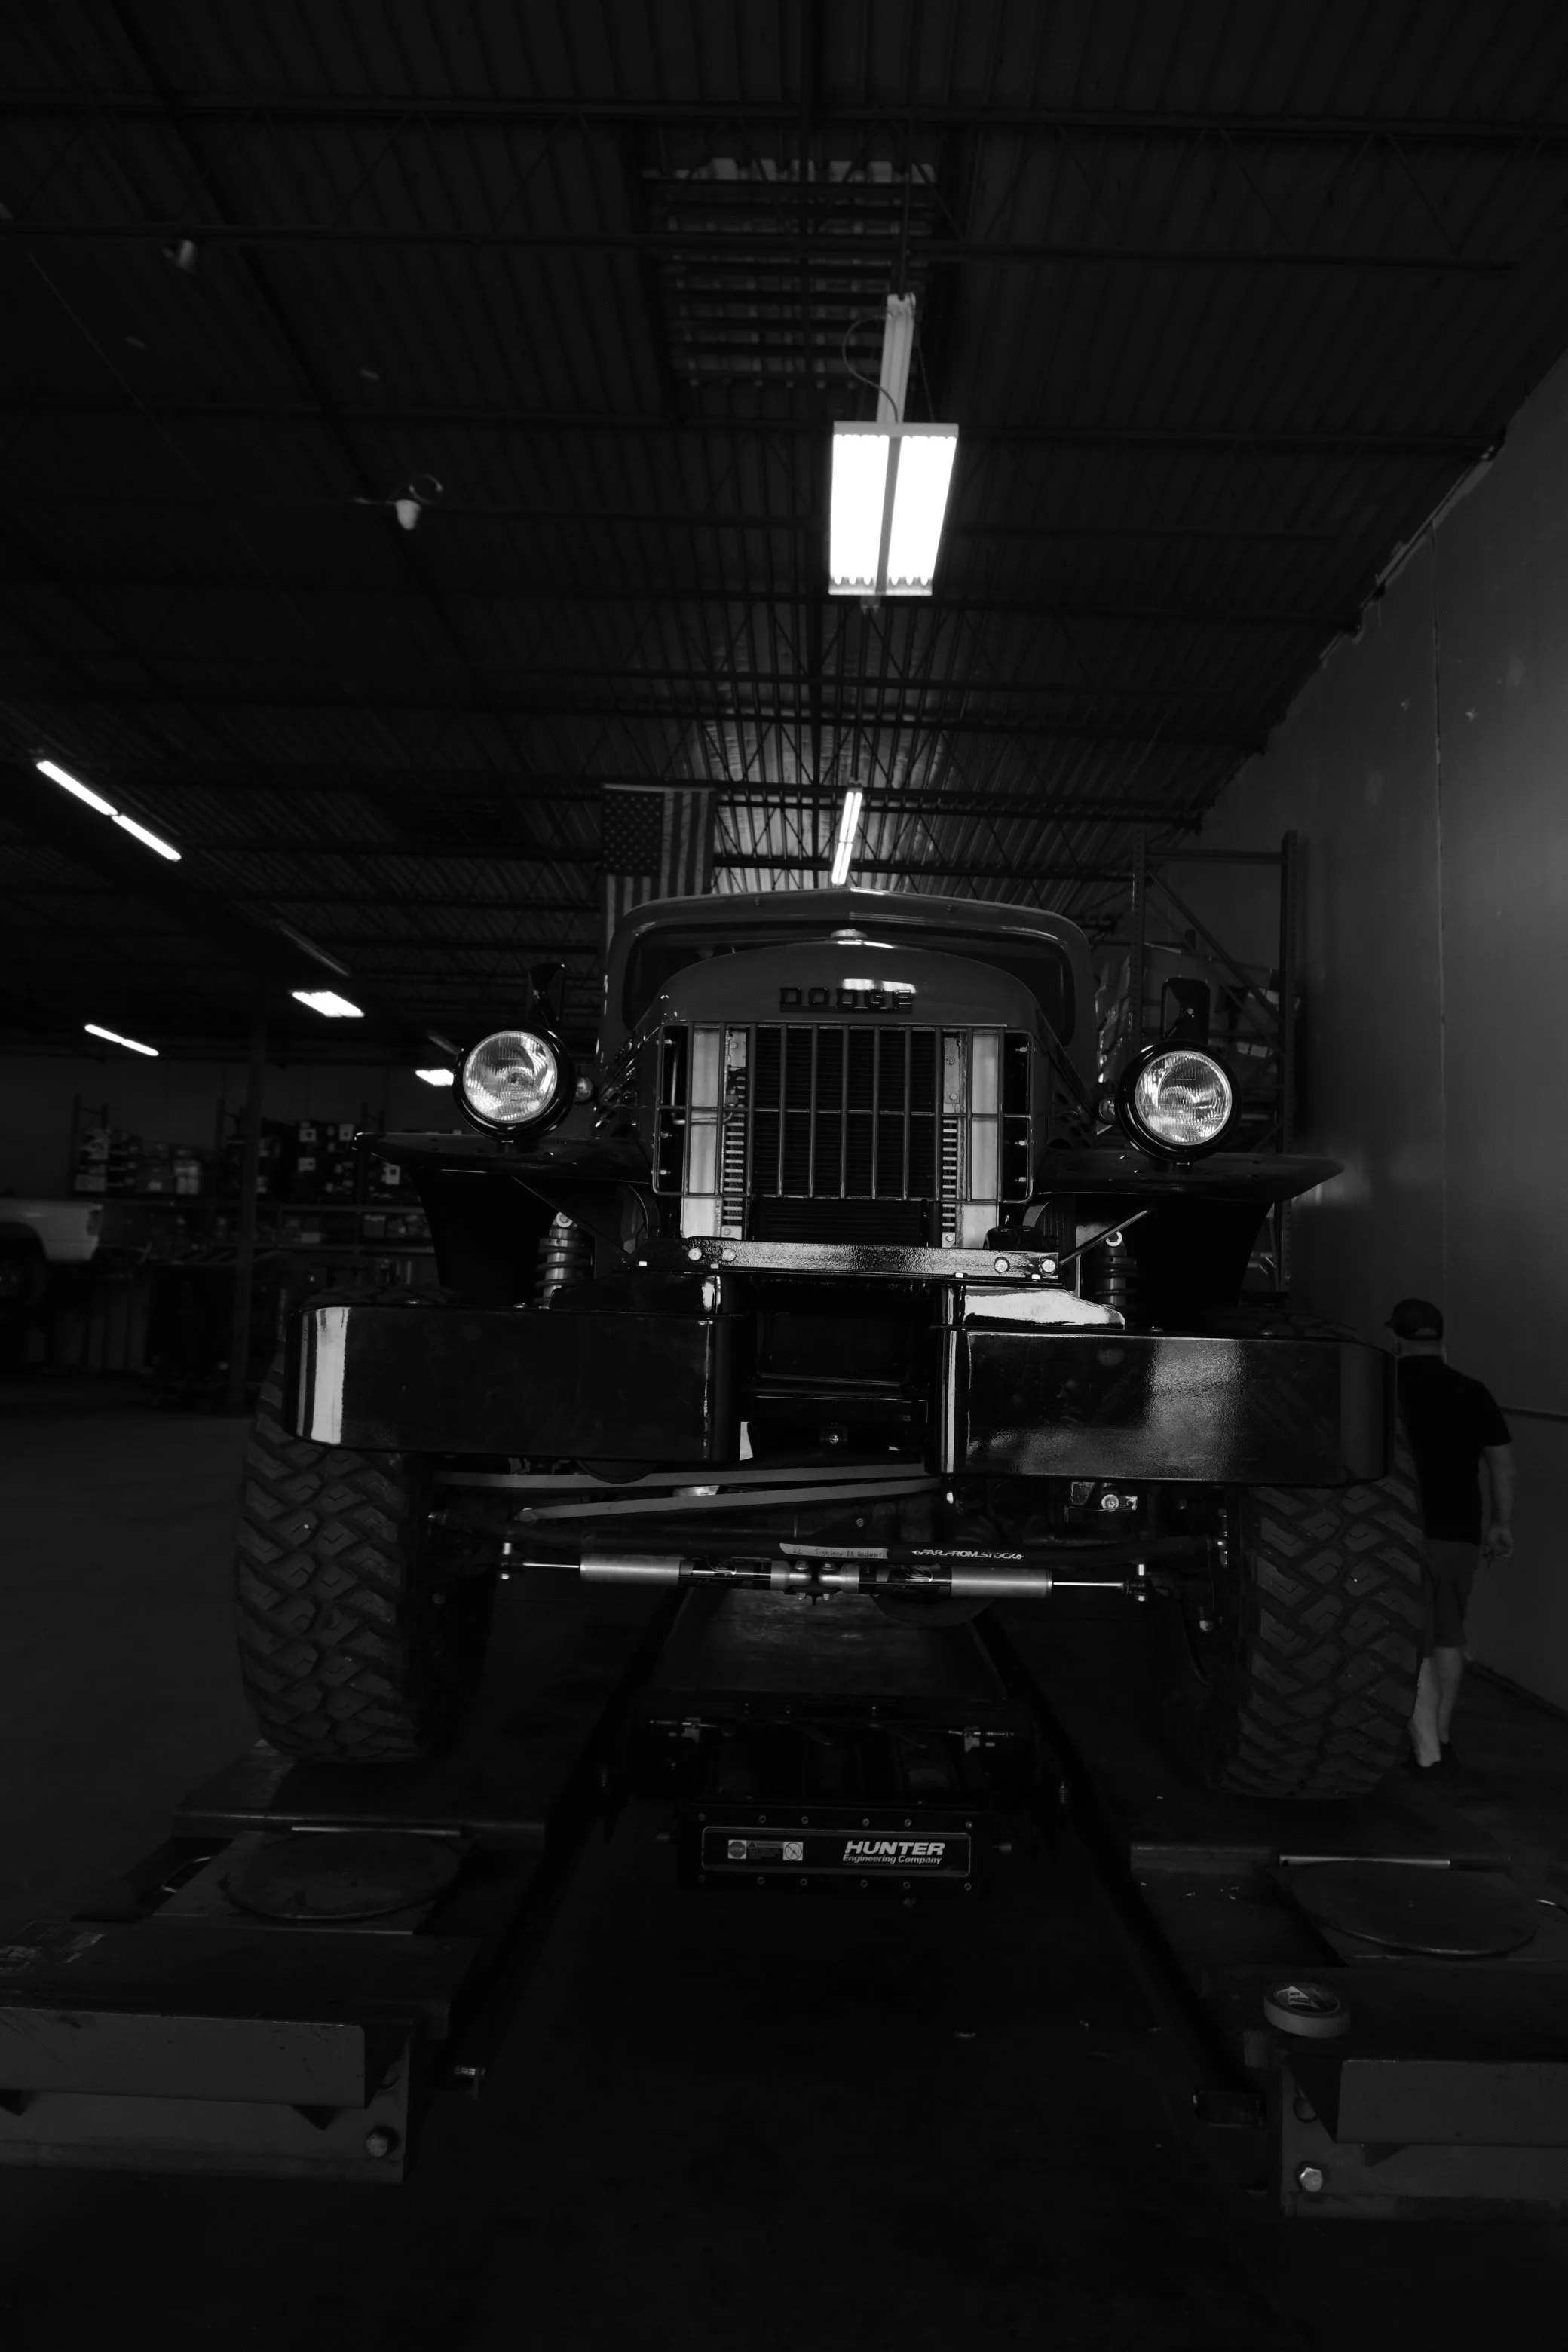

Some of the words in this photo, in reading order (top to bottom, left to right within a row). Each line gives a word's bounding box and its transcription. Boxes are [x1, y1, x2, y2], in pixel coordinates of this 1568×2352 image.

[779, 988, 912, 1011] DODGE
[844, 1840, 946, 1856] HUNTER
[842, 1854, 896, 1864] Engineering
[898, 1855, 942, 1865] Company
